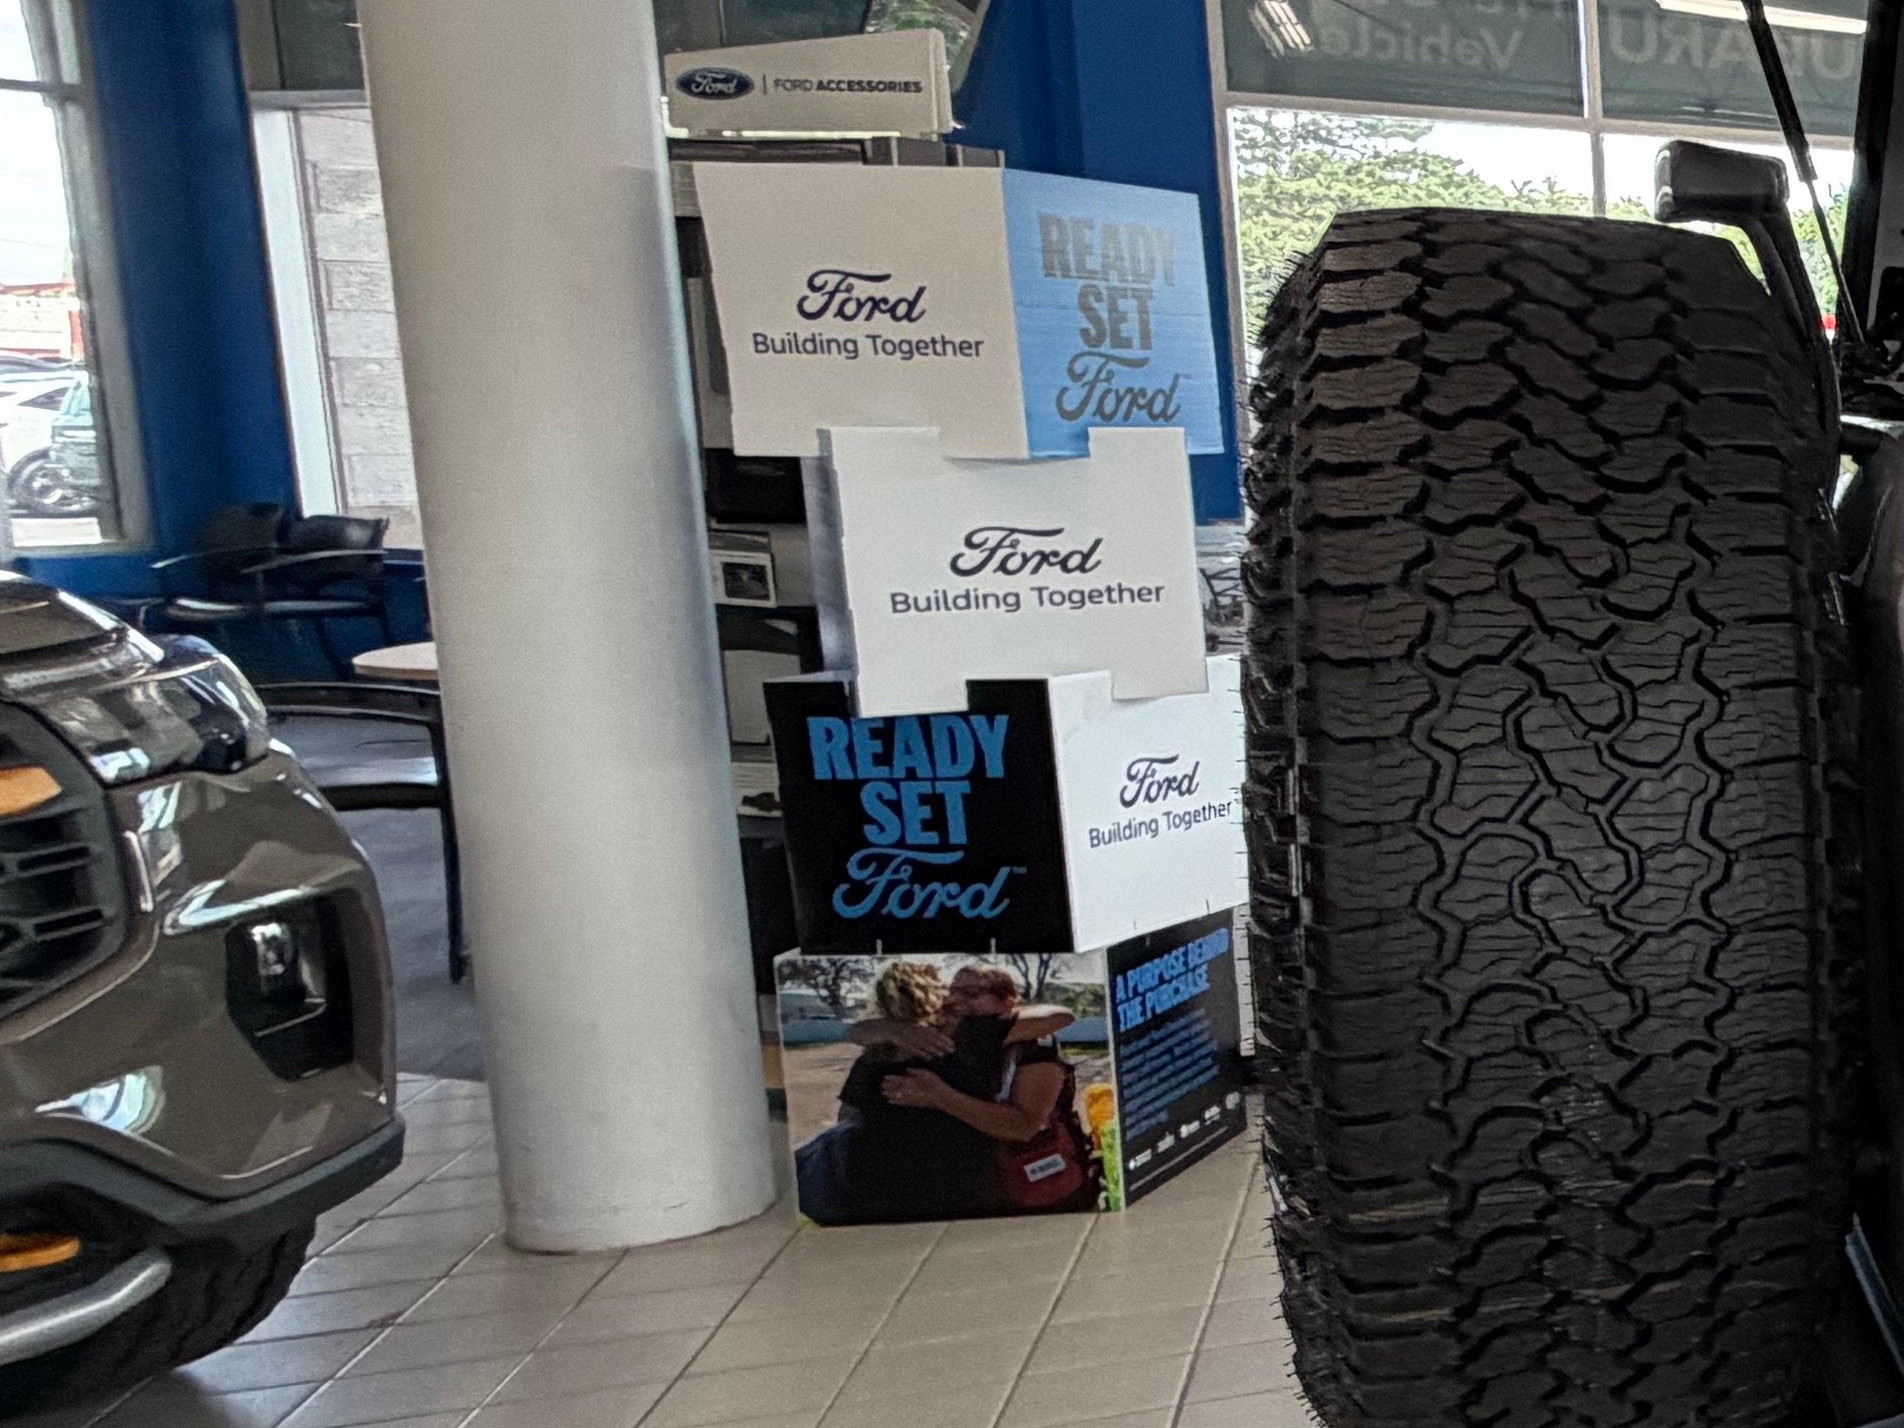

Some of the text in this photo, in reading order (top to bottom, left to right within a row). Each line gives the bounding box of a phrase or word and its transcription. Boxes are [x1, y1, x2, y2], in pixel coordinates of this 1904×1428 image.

[691, 72, 923, 96] Ford FORD ACCESSORIES
[1038, 212, 1176, 286] READY
[797, 269, 927, 324] Ford
[1077, 286, 1154, 351] SET
[752, 331, 985, 361] Building Together
[1055, 351, 1181, 424] Ford
[949, 526, 1104, 579] Ford
[890, 581, 1166, 615] Building Together
[806, 714, 1009, 780] READY
[1118, 753, 1201, 810] Ford
[860, 780, 972, 846] SET
[1088, 799, 1234, 850] Building Together
[832, 847, 1011, 920] Ford
[1116, 974, 1127, 1004] A
[1127, 946, 1187, 999] PURPOSE
[1117, 962, 1210, 1032] THE PURCHASE
